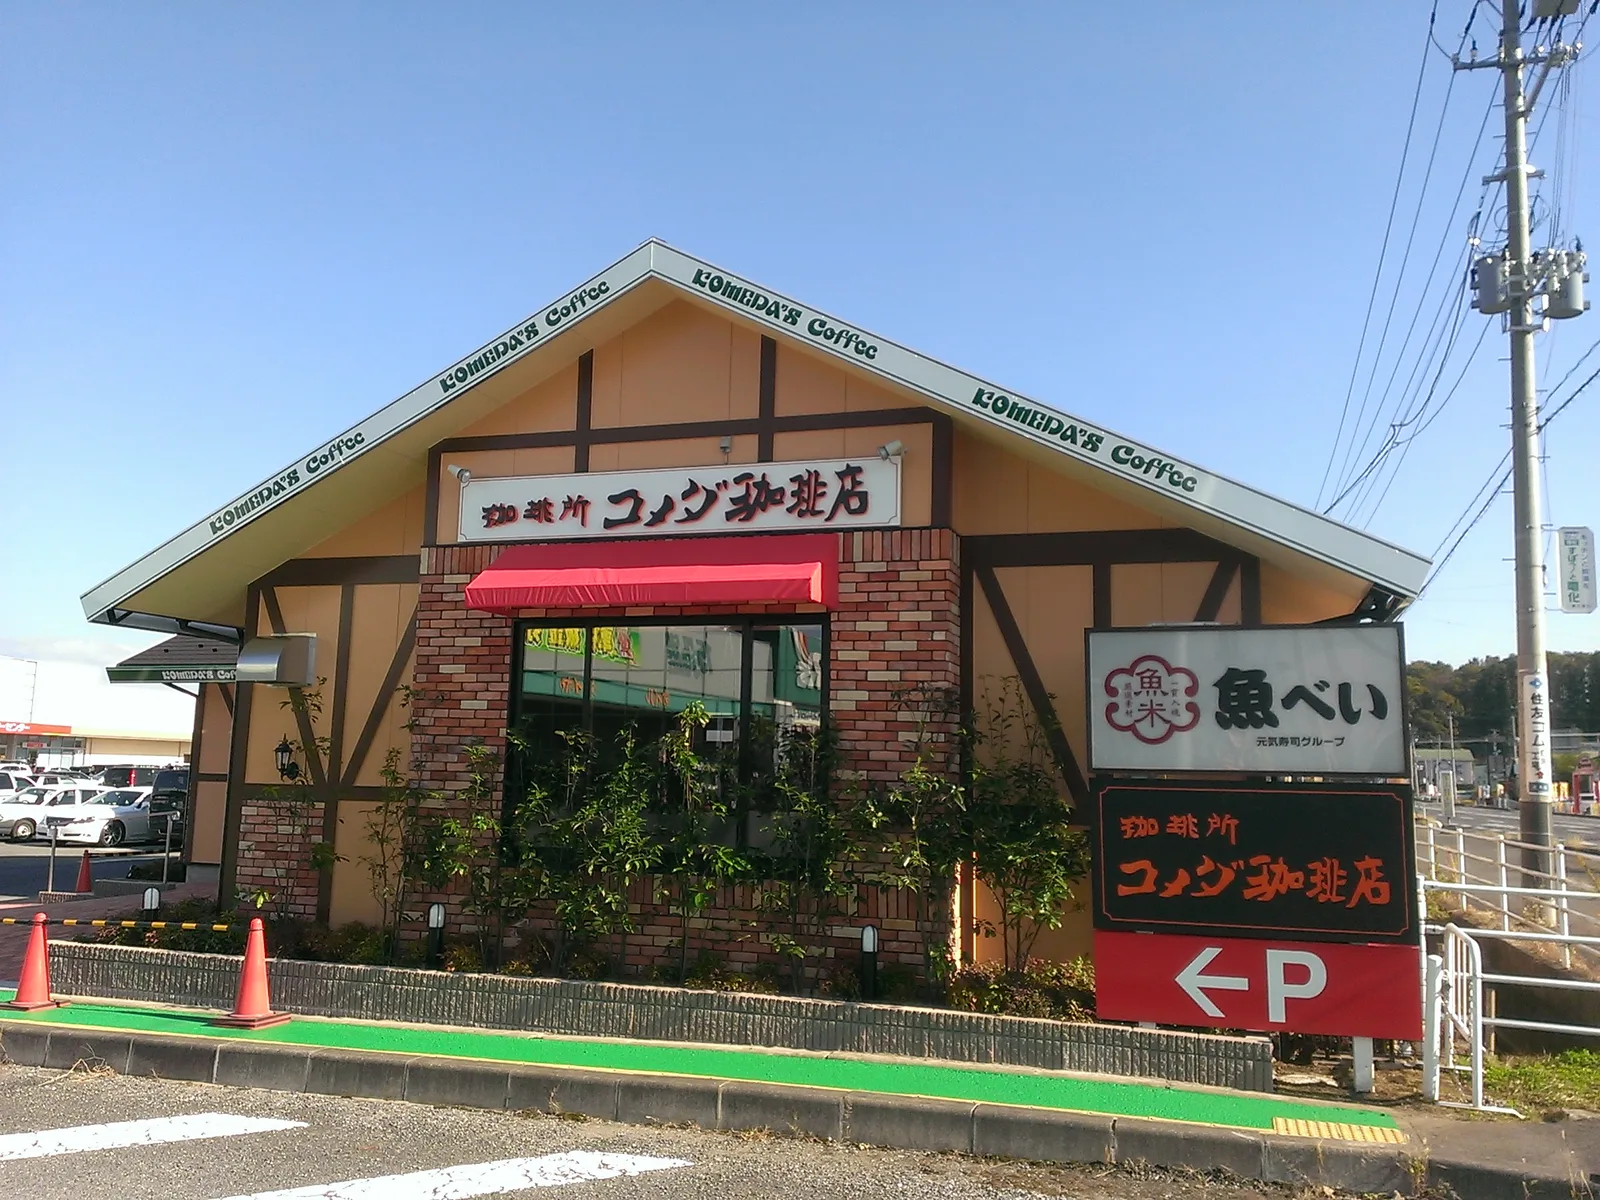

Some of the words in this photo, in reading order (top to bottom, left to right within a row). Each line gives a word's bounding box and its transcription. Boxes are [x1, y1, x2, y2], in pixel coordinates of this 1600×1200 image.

[439, 321, 540, 394] KOMEDA'S
[544, 279, 610, 327] Coffee
[690, 267, 802, 327] KOMEDA'S
[806, 316, 878, 361] Coffee
[971, 387, 1105, 453] KOMEDA'S
[1110, 444, 1198, 494] Coffee
[209, 467, 300, 536] KOMEDA'S
[305, 430, 366, 475] Coffee
[602, 463, 870, 530] コメダ珈琲店
[161, 670, 214, 680] KOMEDA'S
[1211, 667, 1389, 731] 魚べい
[1256, 736, 1346, 748] 元気寿司グループ
[1117, 855, 1391, 909] コメダ珈琲店
[1266, 948, 1328, 1024] P
